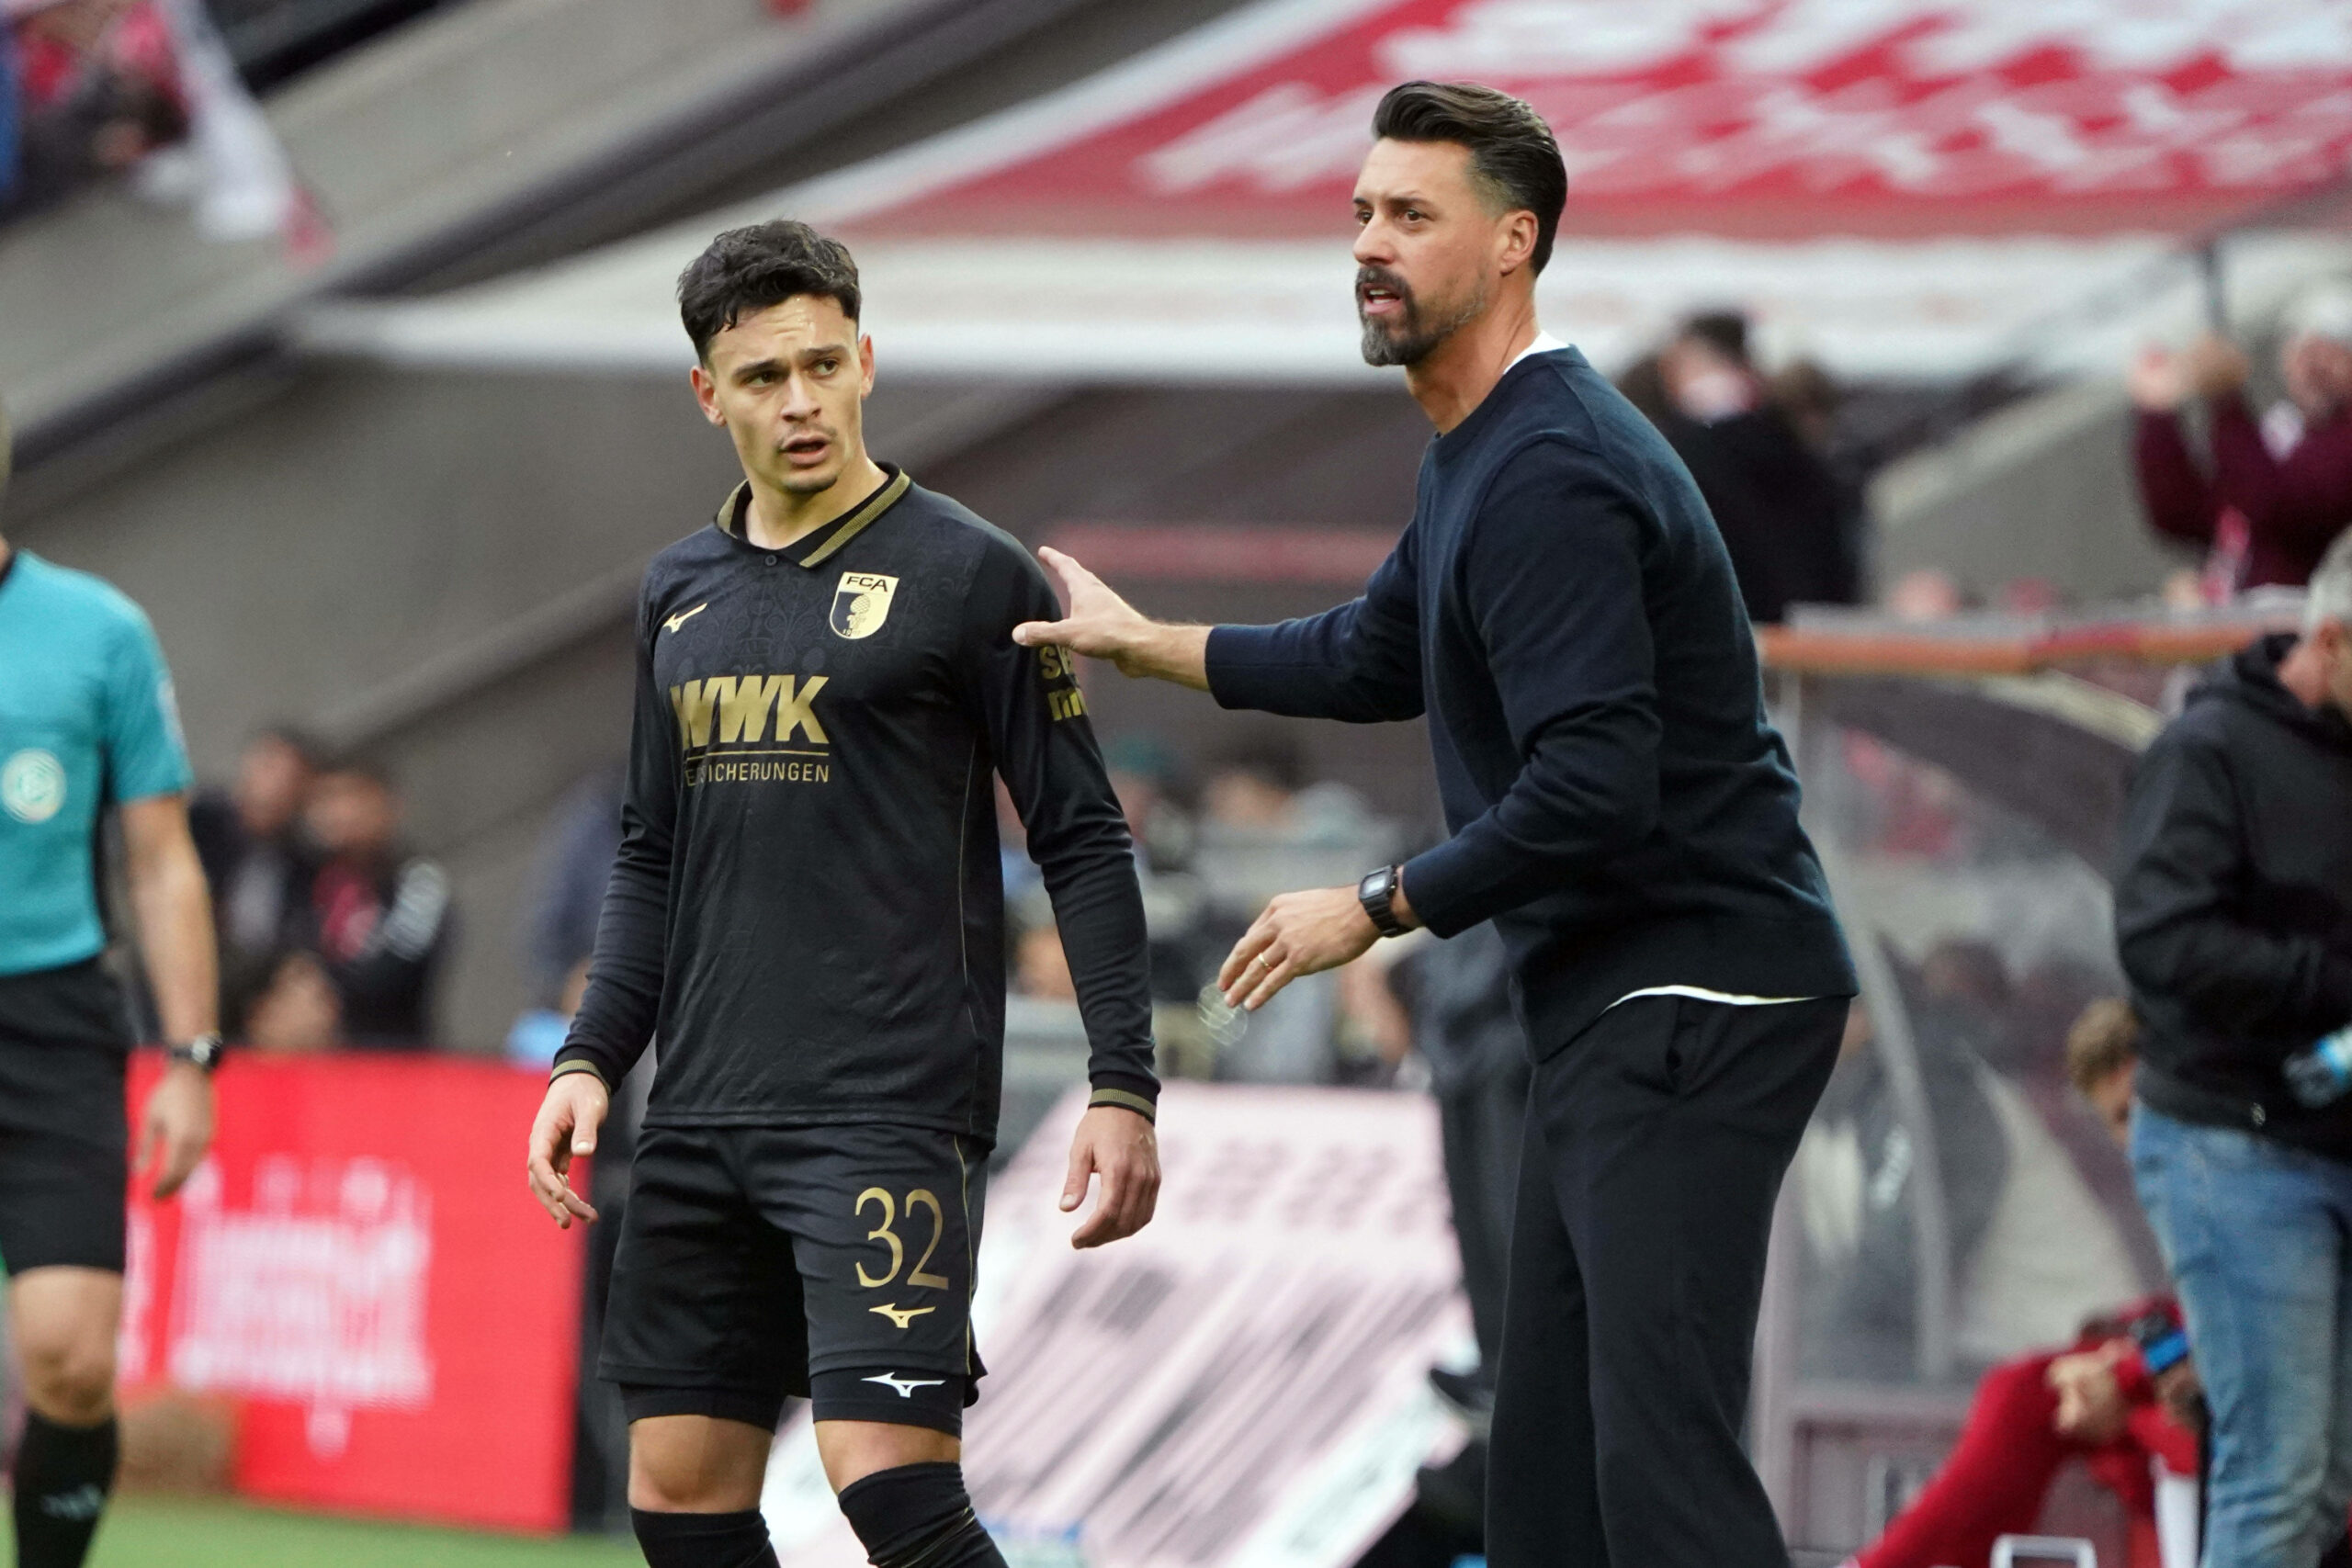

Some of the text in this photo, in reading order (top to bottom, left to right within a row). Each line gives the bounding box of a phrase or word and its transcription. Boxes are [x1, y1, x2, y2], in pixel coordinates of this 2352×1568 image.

[846, 576, 888, 592] FCA
[669, 674, 831, 750] WWK
[854, 1187, 949, 1290] 32
